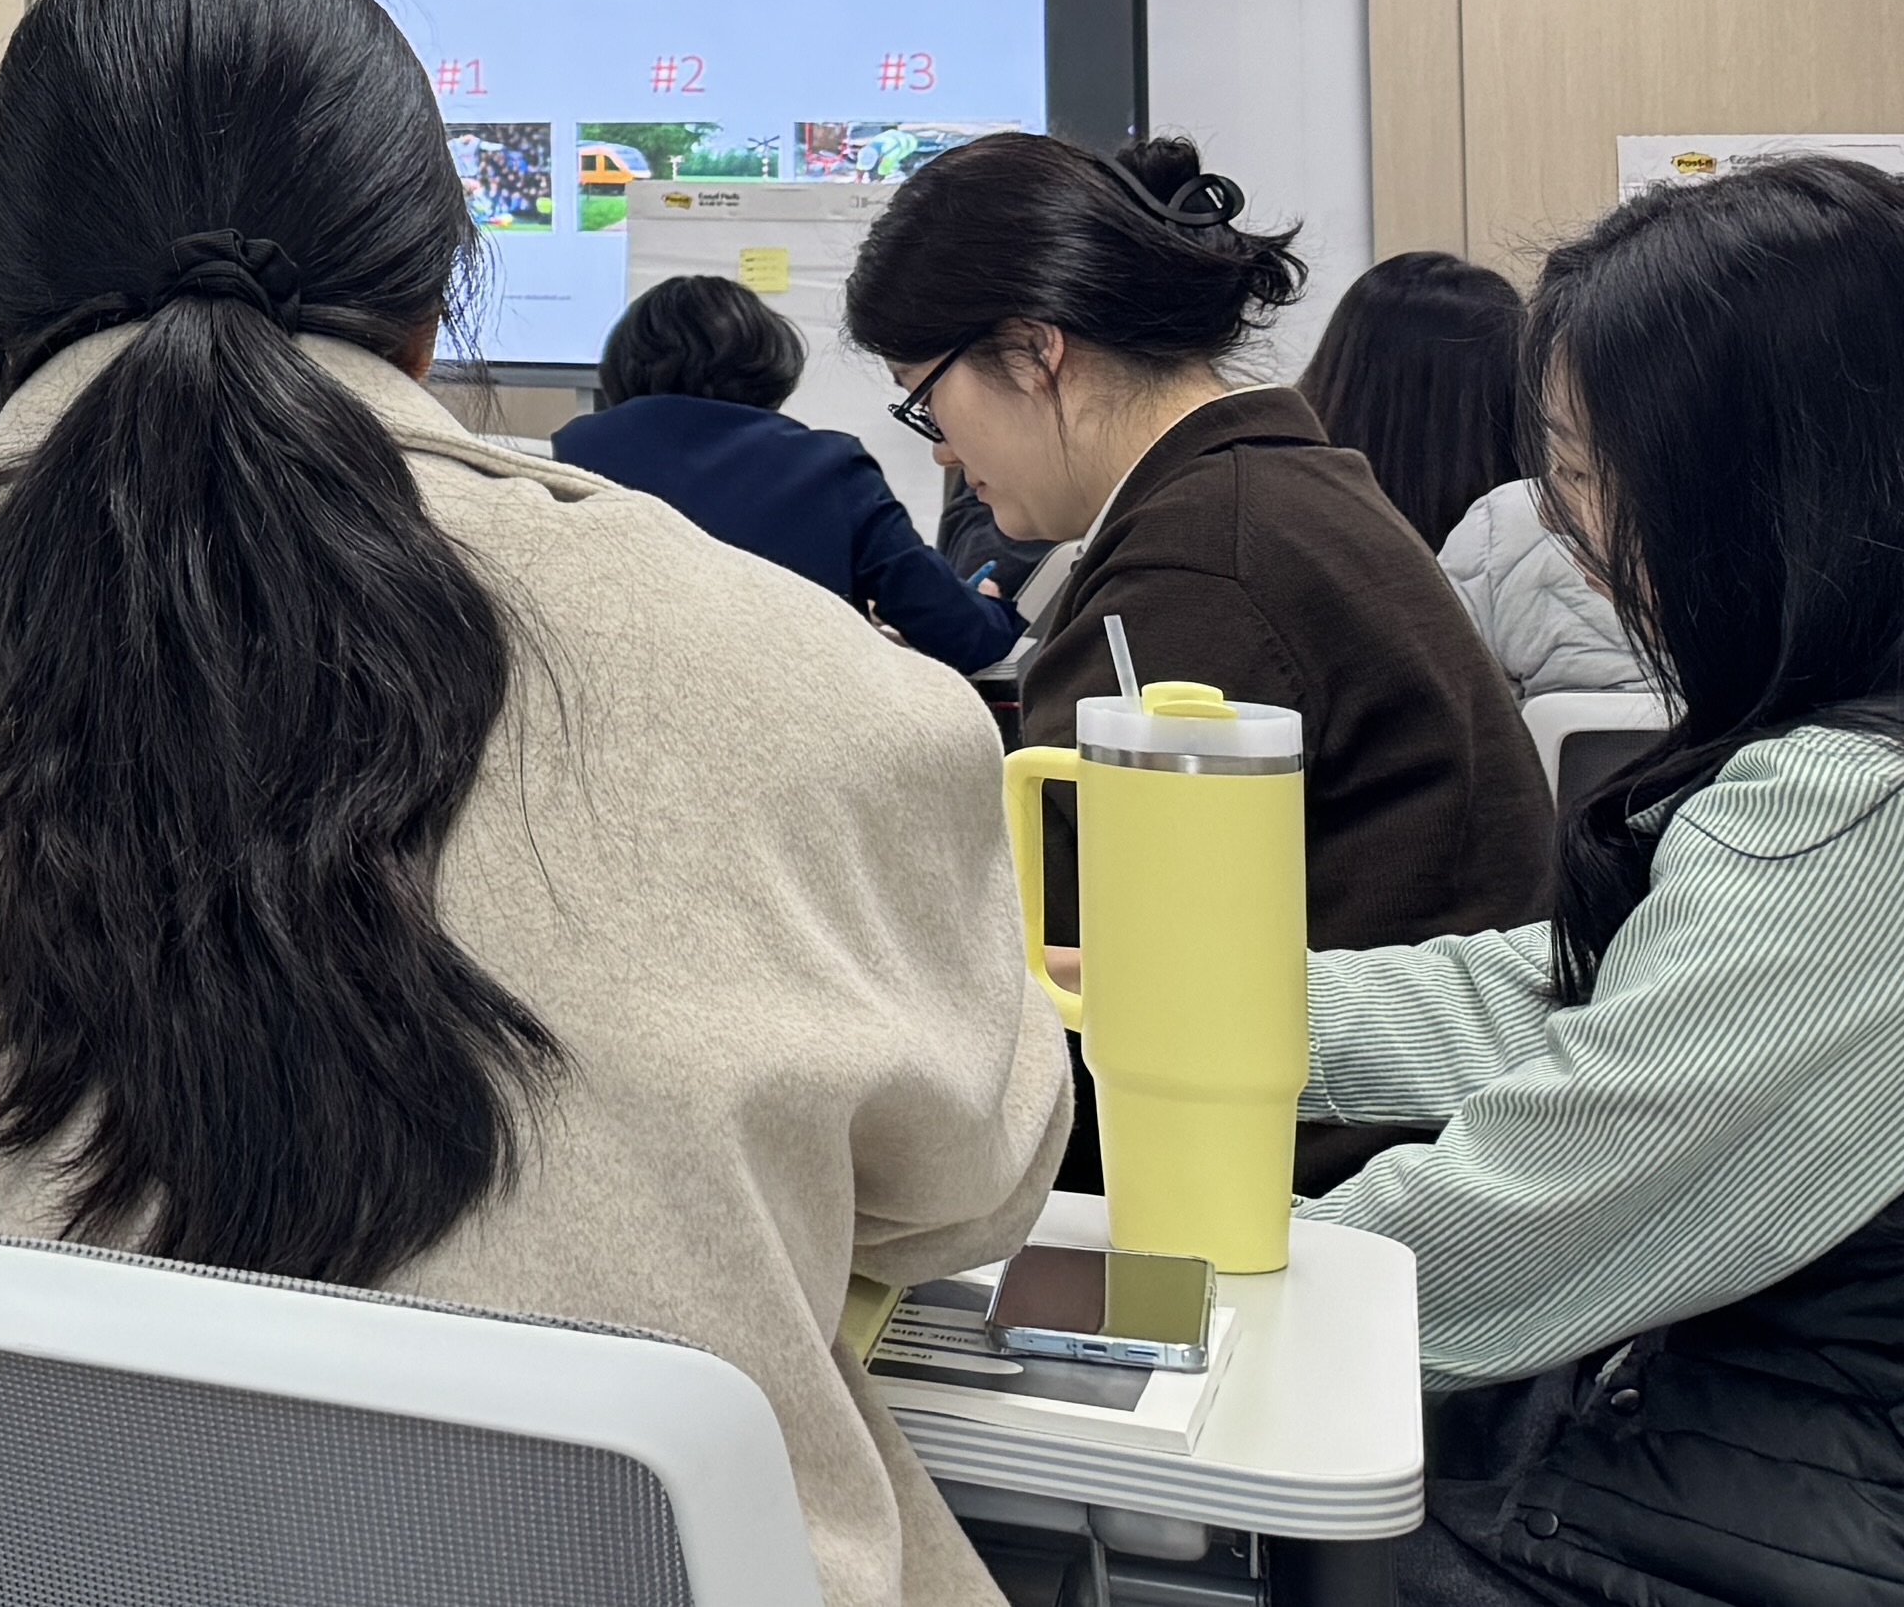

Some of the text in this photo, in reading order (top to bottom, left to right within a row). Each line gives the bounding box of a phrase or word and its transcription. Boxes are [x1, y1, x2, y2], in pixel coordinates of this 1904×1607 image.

[436, 52, 937, 96] #1 #2 #3
